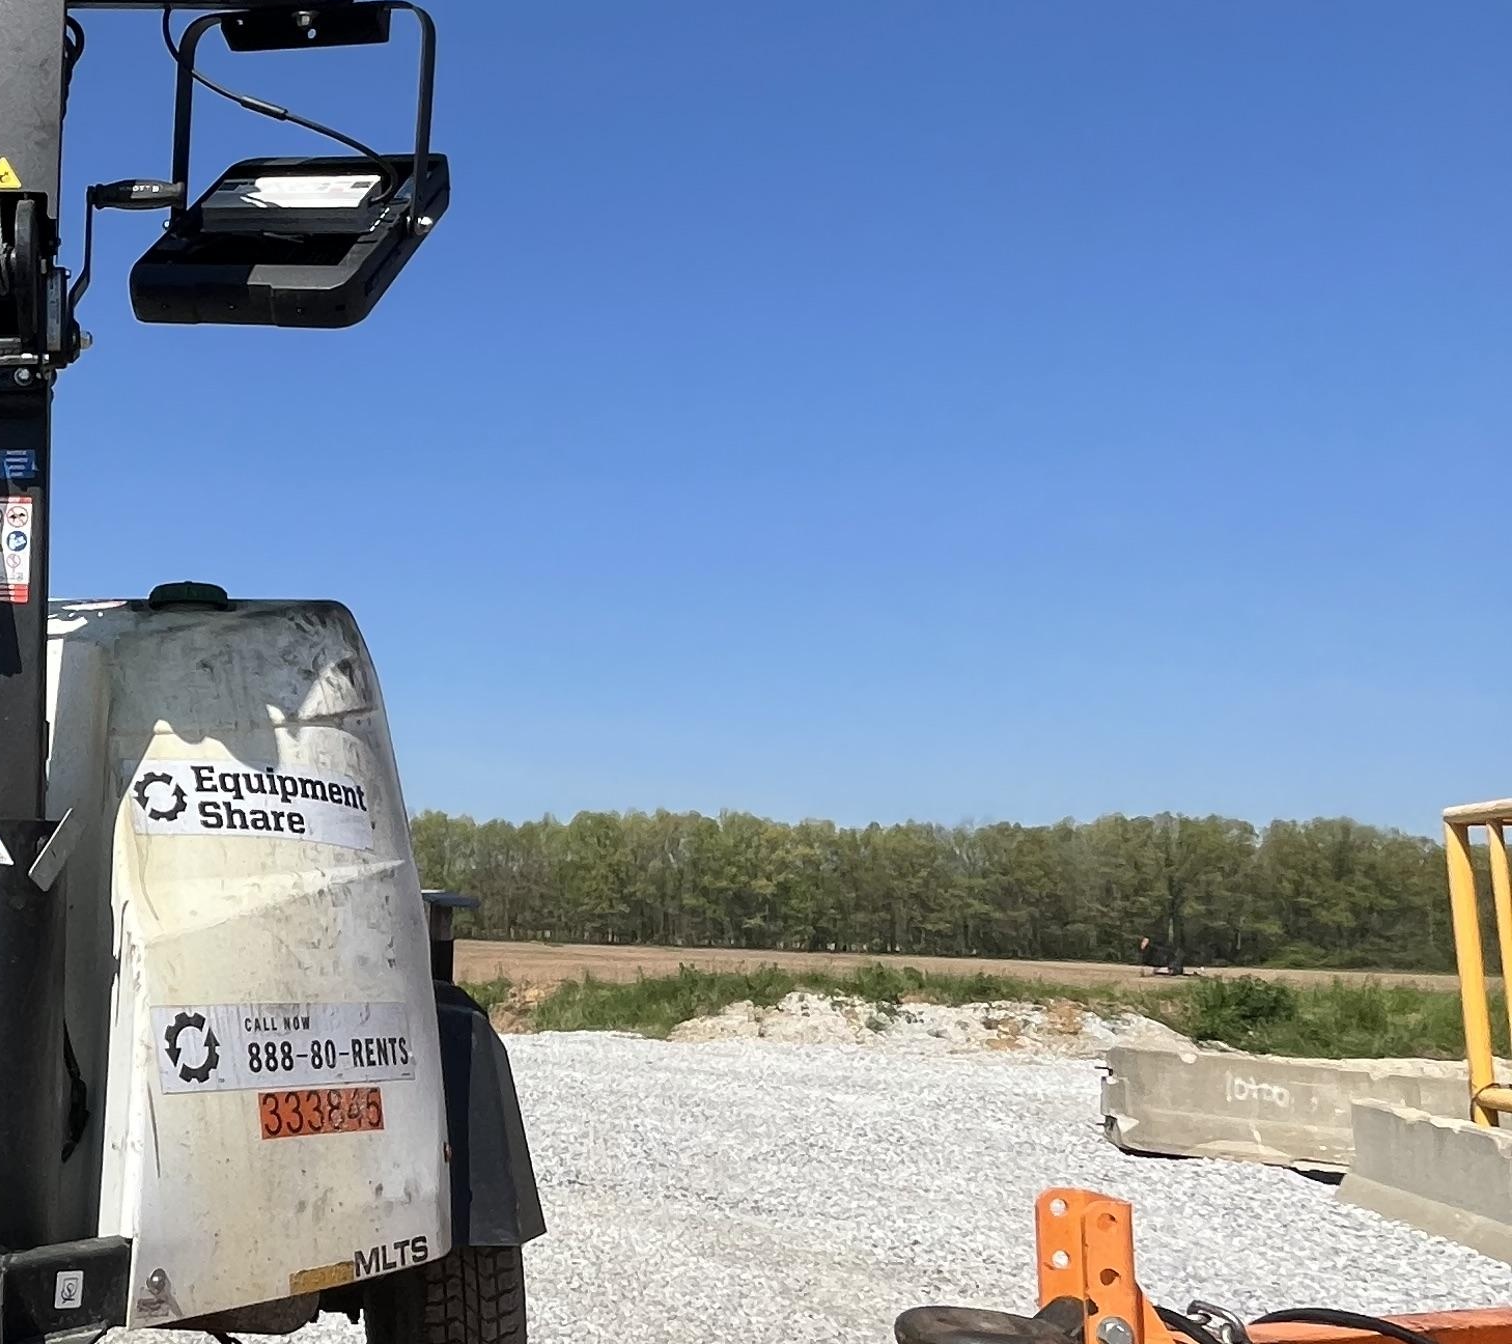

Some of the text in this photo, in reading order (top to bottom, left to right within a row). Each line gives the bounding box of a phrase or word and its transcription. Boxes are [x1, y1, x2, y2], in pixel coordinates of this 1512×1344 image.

[190, 765, 368, 812] Equipment
[197, 800, 306, 834] Share
[244, 1016, 311, 1032] CALL NOW
[247, 1036, 410, 1073] 888-80-RENTS
[353, 1235, 429, 1278] MLTS
